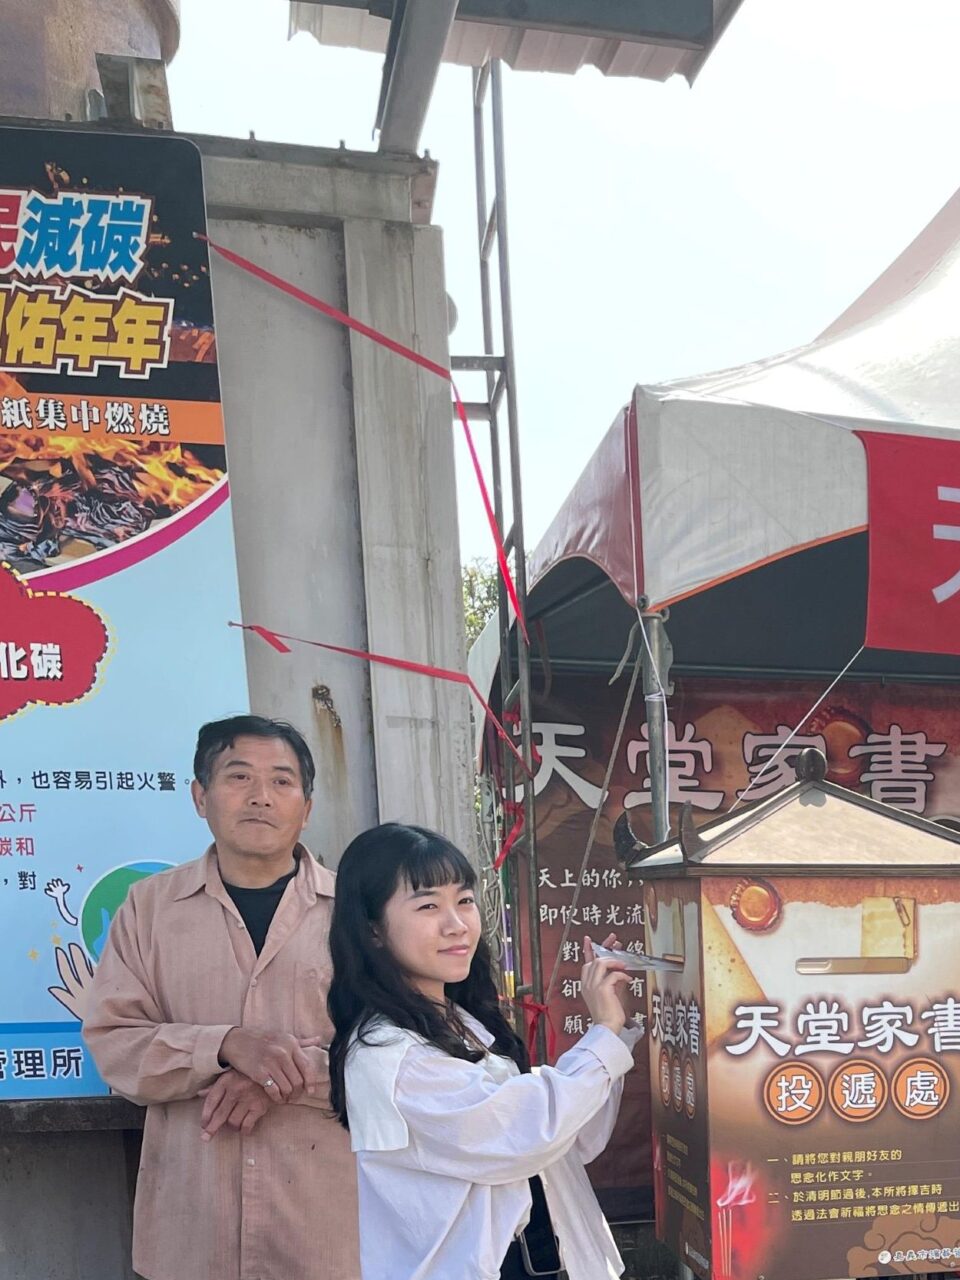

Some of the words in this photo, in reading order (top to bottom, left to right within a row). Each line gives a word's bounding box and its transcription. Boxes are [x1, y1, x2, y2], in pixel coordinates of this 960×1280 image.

[0, 290, 165, 371] 佑年年
[1, 396, 170, 435] 紙集中燃燒
[502, 719, 948, 815] 天堂家書
[0, 803, 37, 823] 公斤
[0, 1047, 83, 1079] 理所
[776, 1069, 941, 1114] 投遞處
